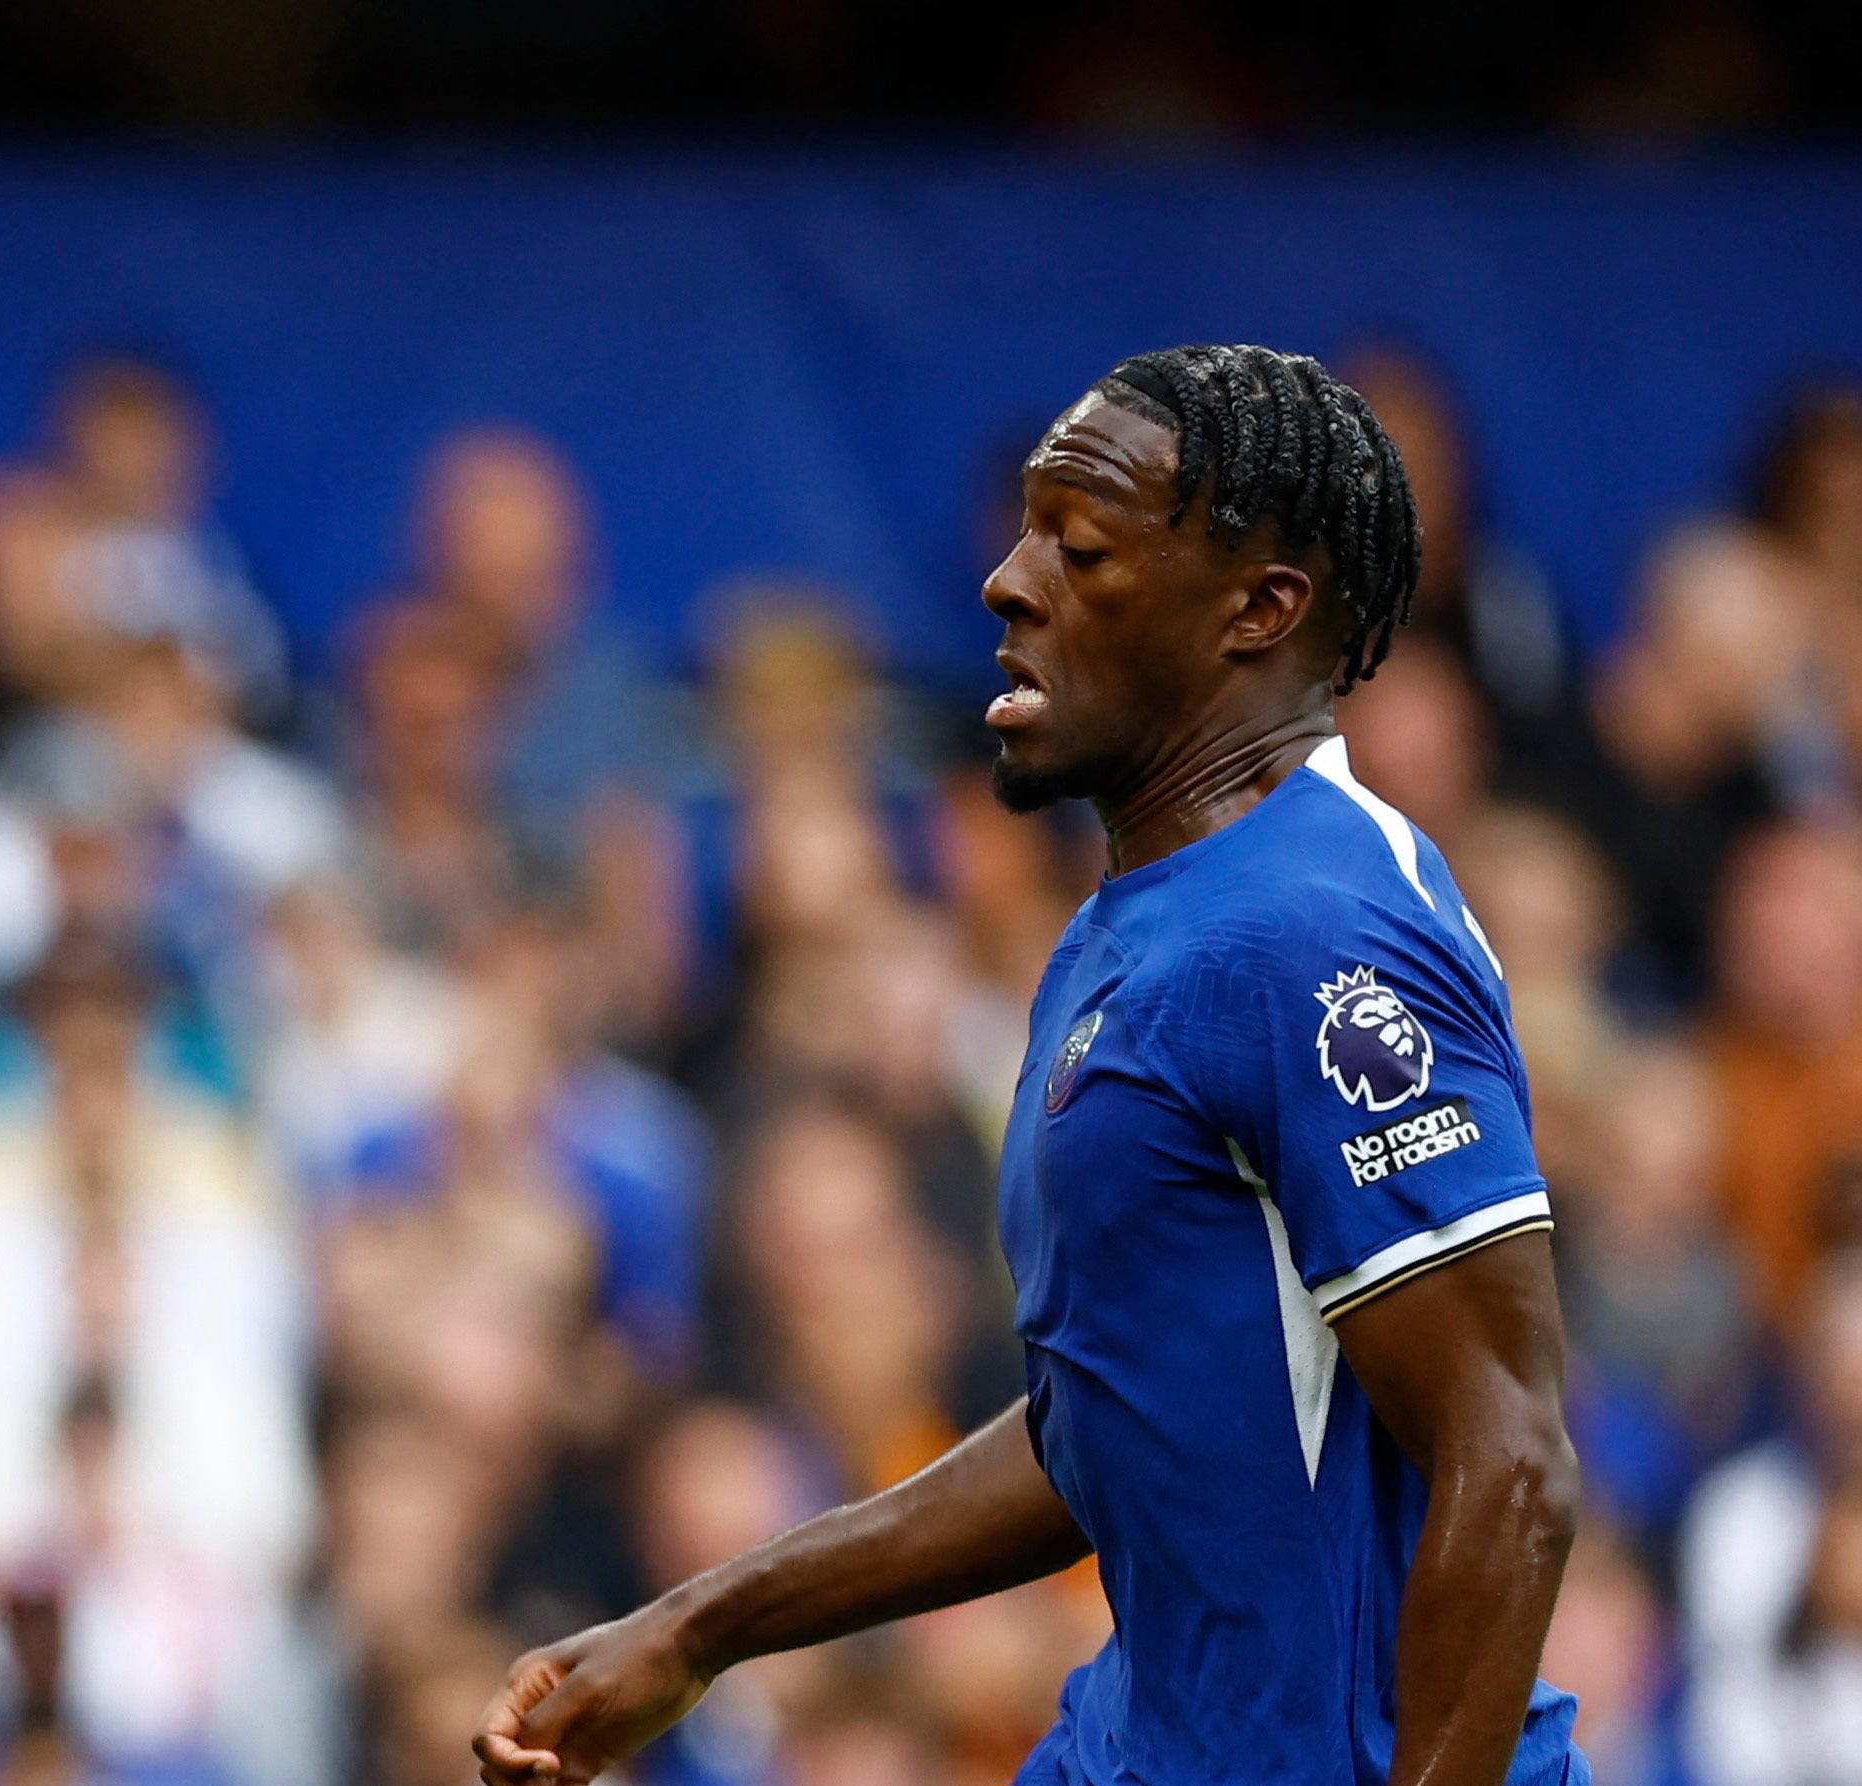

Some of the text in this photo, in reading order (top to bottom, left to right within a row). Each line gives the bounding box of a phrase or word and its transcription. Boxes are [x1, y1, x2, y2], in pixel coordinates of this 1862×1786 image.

[1340, 1104, 1460, 1168] No room
[1348, 1121, 1481, 1188] for racism
